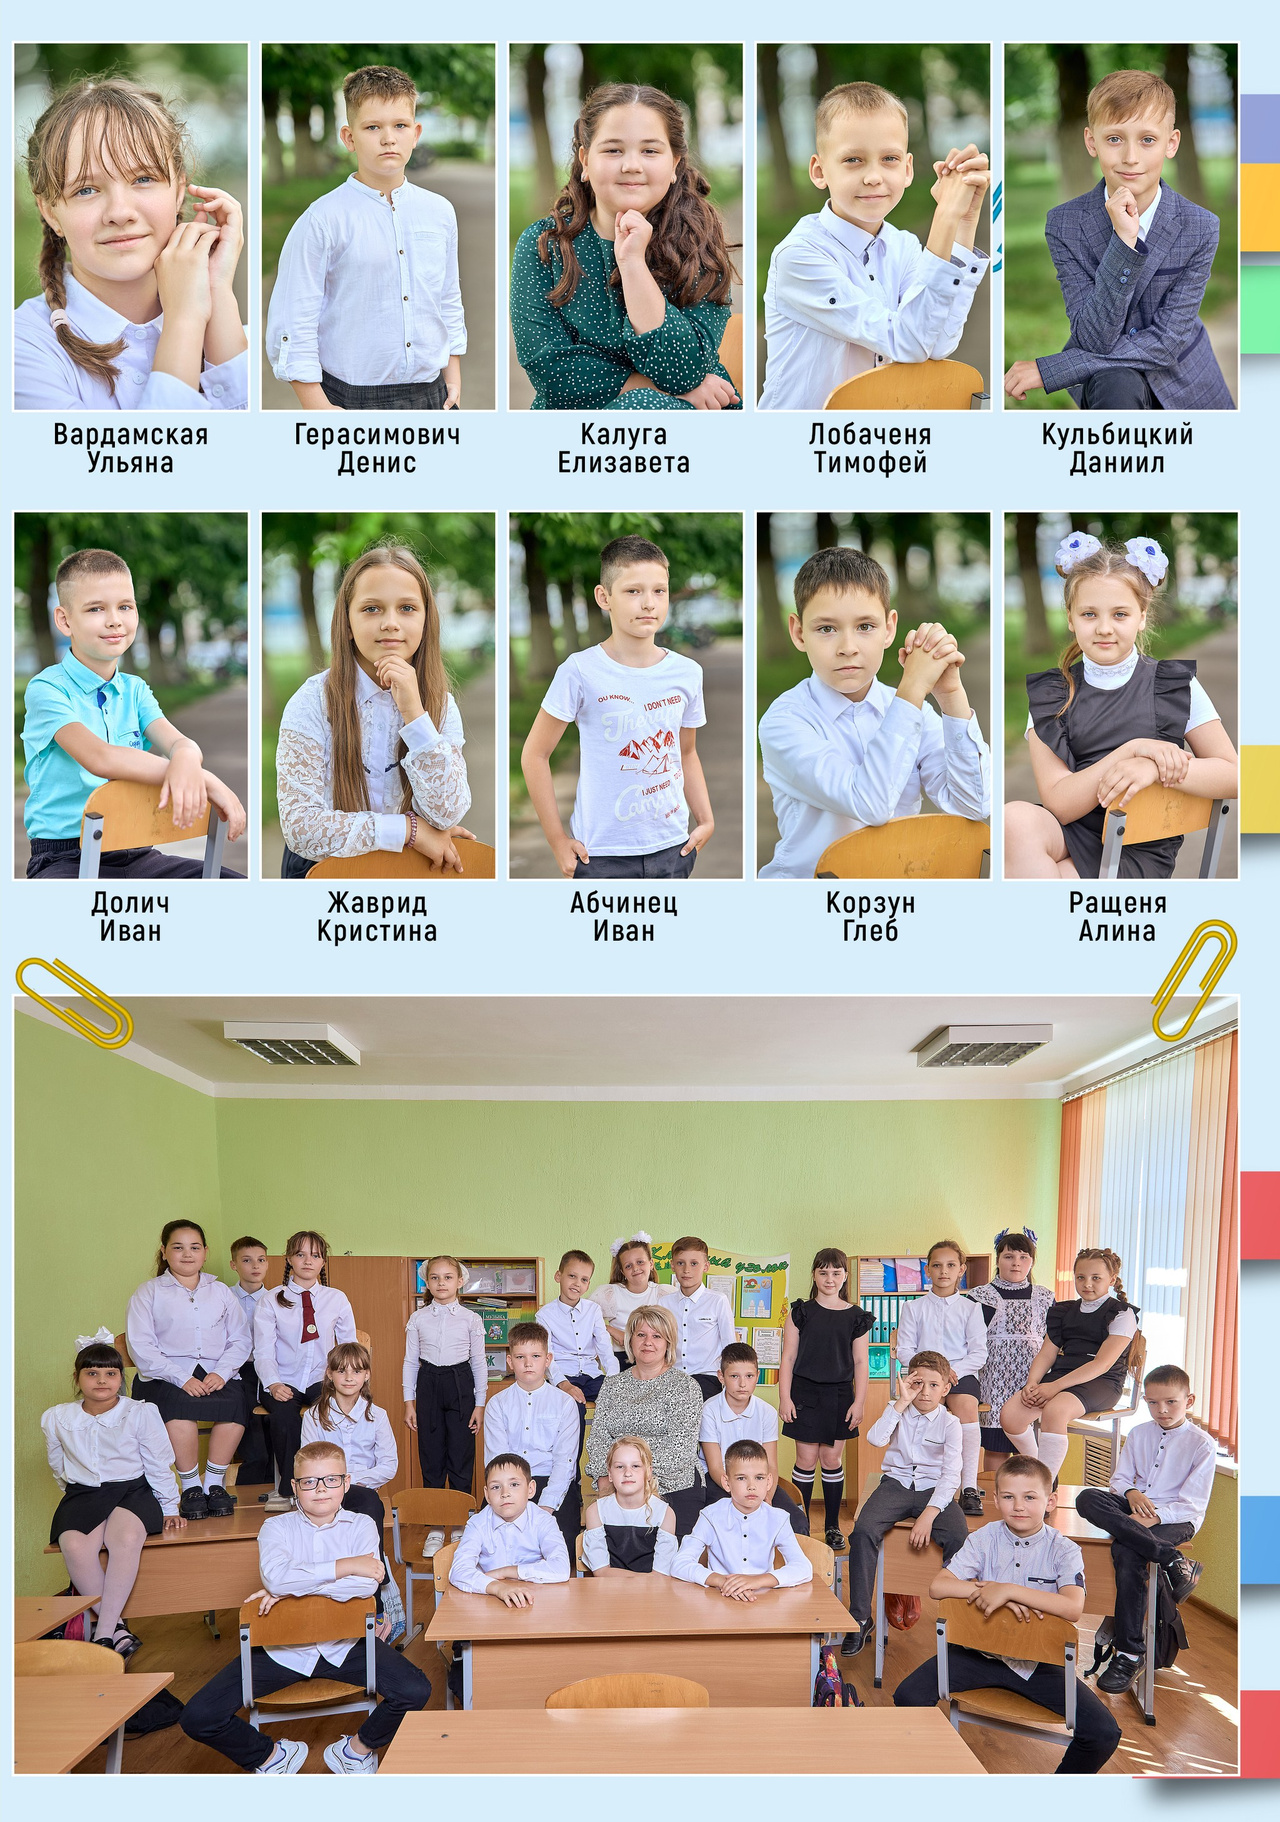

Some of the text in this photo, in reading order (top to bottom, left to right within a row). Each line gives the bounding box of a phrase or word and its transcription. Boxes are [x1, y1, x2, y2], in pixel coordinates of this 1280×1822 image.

[647, 699, 666, 711] DON'T
[666, 695, 682, 706] NEED
[645, 785, 658, 796] JUST
